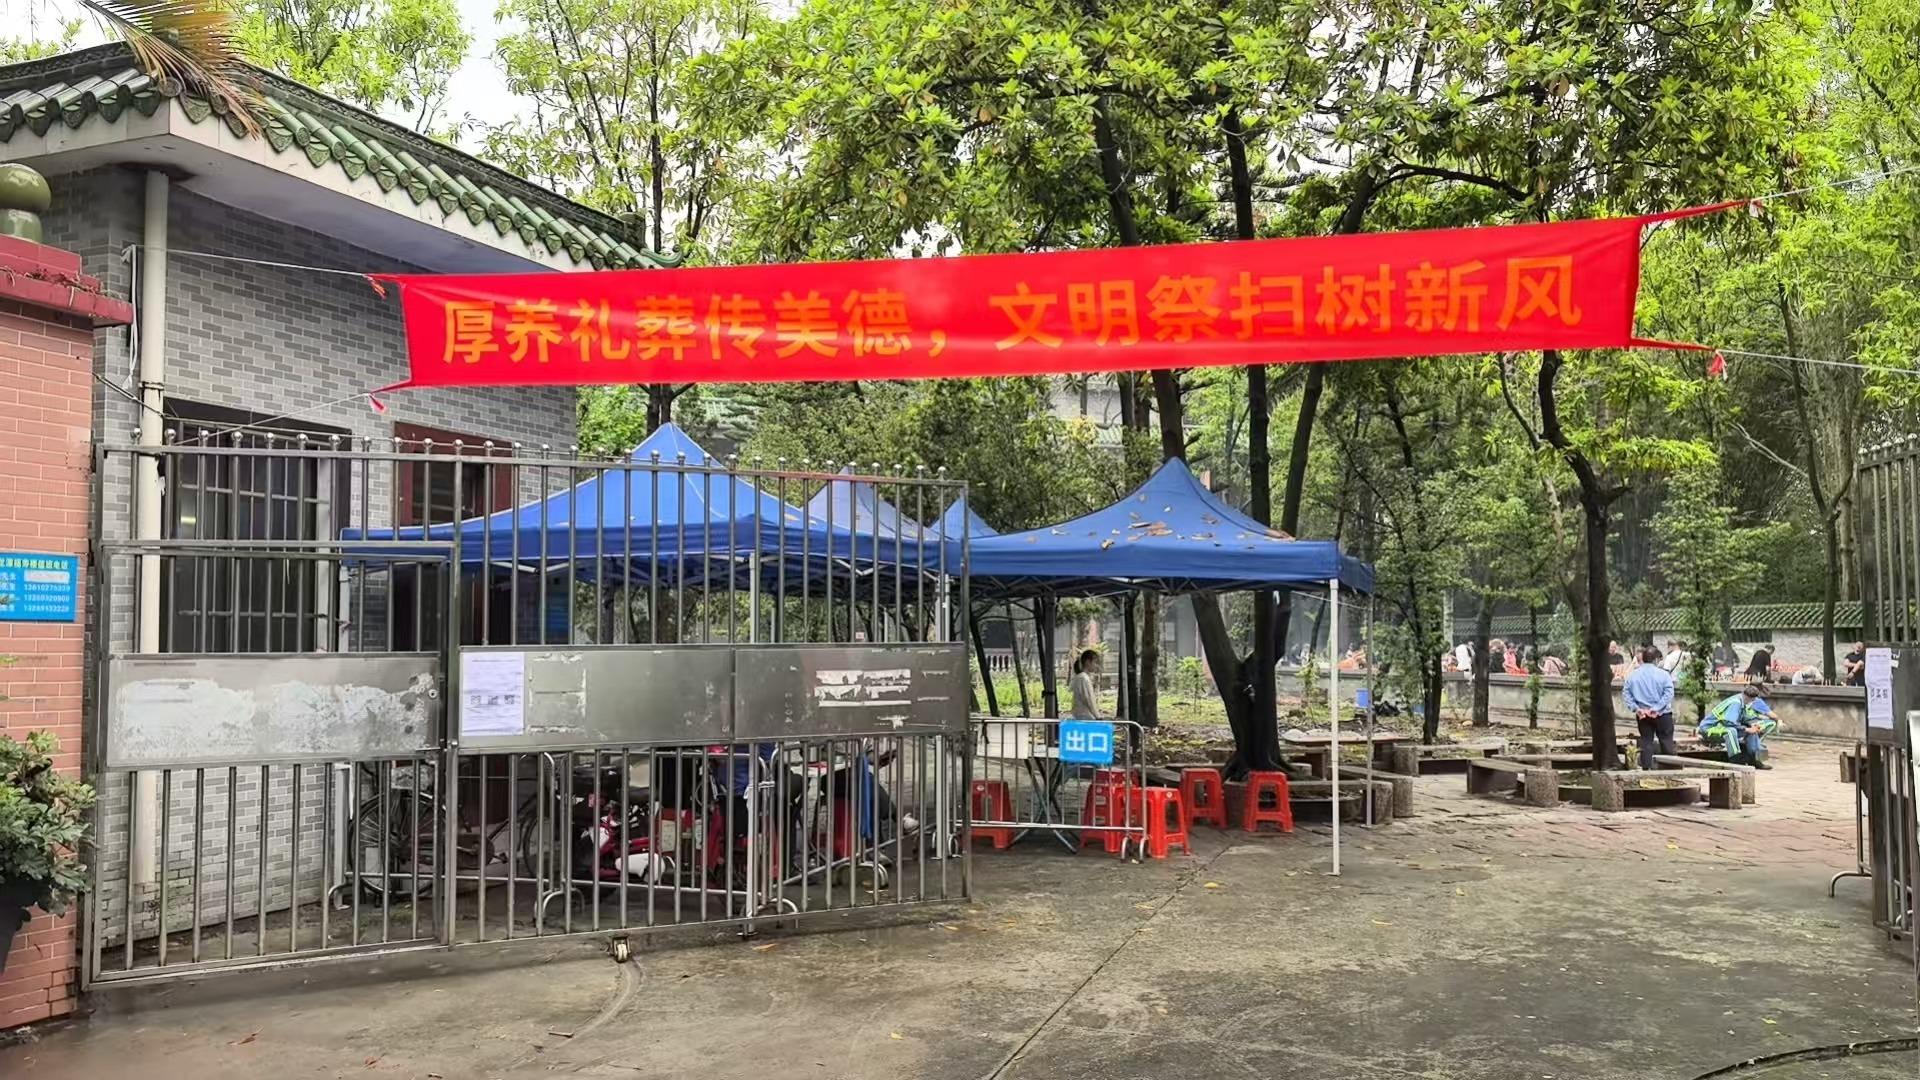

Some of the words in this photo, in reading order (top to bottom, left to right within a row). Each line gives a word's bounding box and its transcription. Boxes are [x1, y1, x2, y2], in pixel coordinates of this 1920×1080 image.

[443, 256, 1582, 364] 厚养礼葬传美德，文明祭扫树新风
[1066, 730, 1108, 753] 出口
